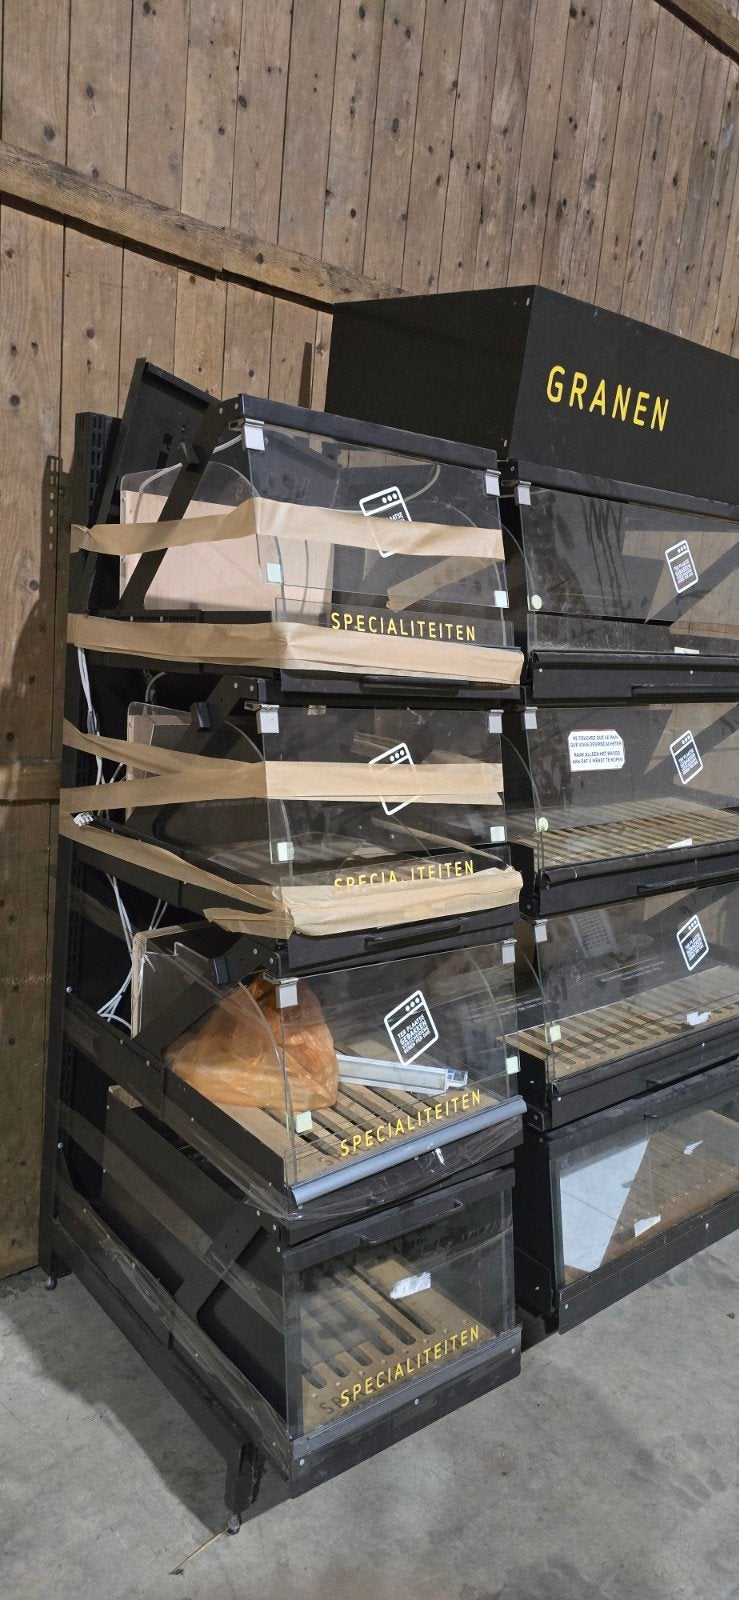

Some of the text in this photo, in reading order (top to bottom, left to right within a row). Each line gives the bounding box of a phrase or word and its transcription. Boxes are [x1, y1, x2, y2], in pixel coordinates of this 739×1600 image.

[546, 365, 669, 432] GRANEN
[331, 612, 476, 641] SPECIALITEITEN
[334, 860, 474, 890] SPECIAITEITEN
[340, 1090, 481, 1157] SPECIALITEITEN
[340, 1325, 479, 1407] SPECIALITEITEN
